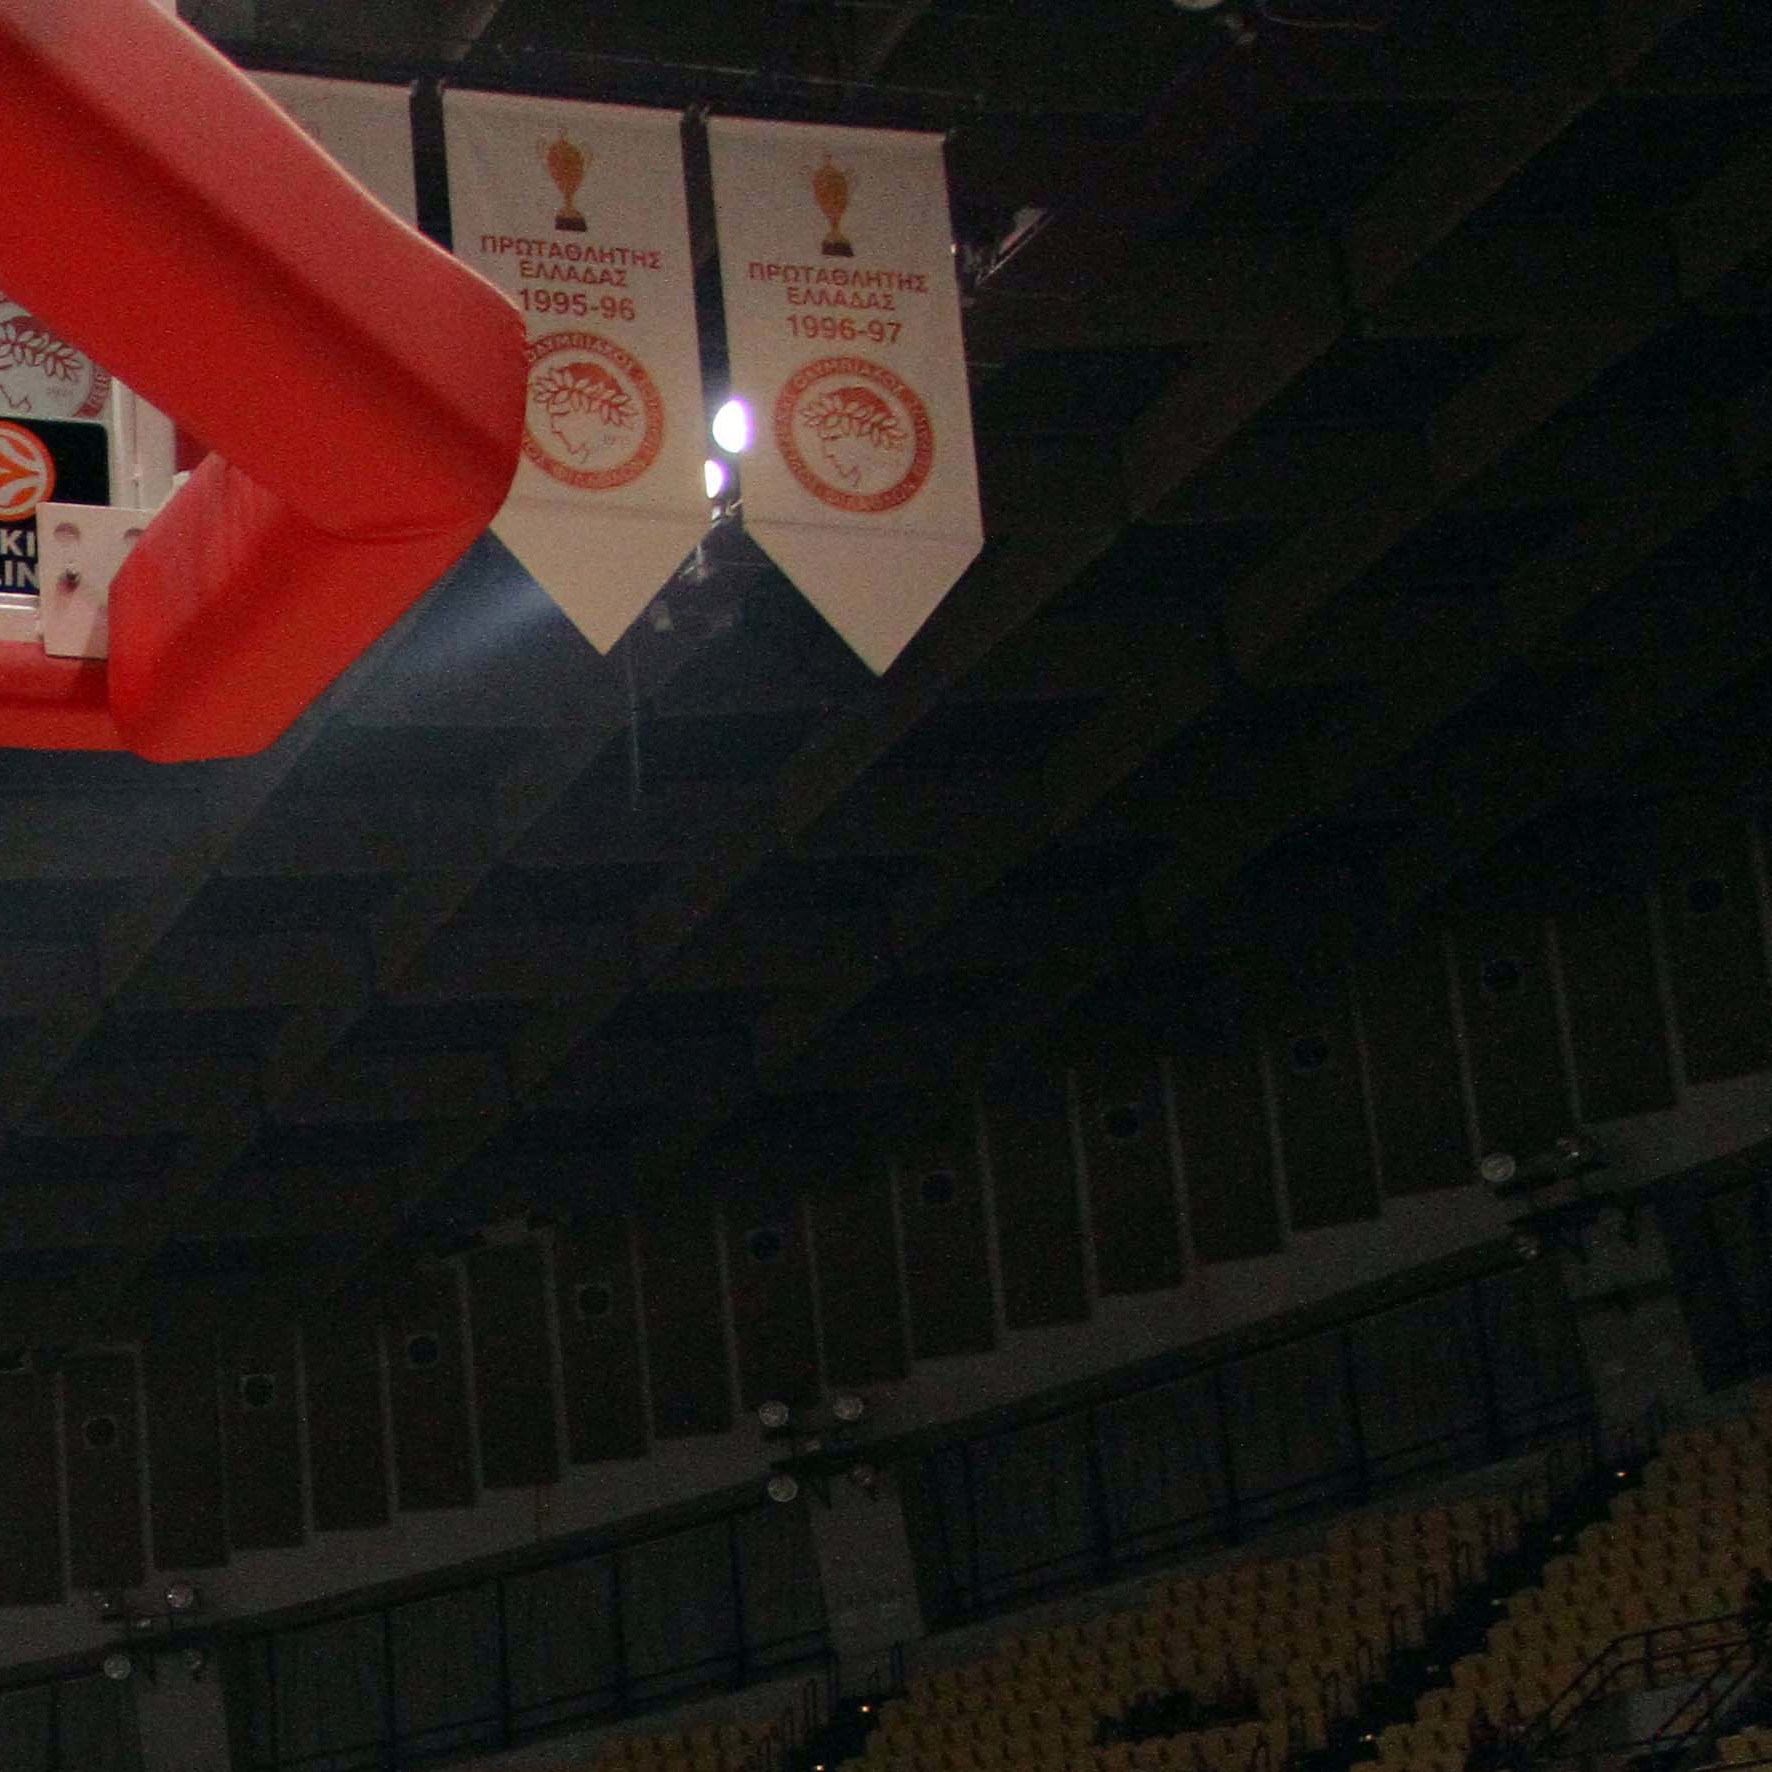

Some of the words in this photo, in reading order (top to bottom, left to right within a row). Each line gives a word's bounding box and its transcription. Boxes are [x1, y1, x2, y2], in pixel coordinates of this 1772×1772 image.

[479, 233, 662, 271] ΠΡΩΤΑΘΛΗΤΗΣ
[519, 260, 627, 288] ΕΛΛΑΔΑΣ
[748, 260, 930, 294] ΠΡΩΤΑΘΛΗΤΗΣ
[518, 288, 636, 322] 1995-96
[785, 286, 896, 312] ΕΛΛΑΔΑΣ
[785, 312, 903, 344] 1996-97
